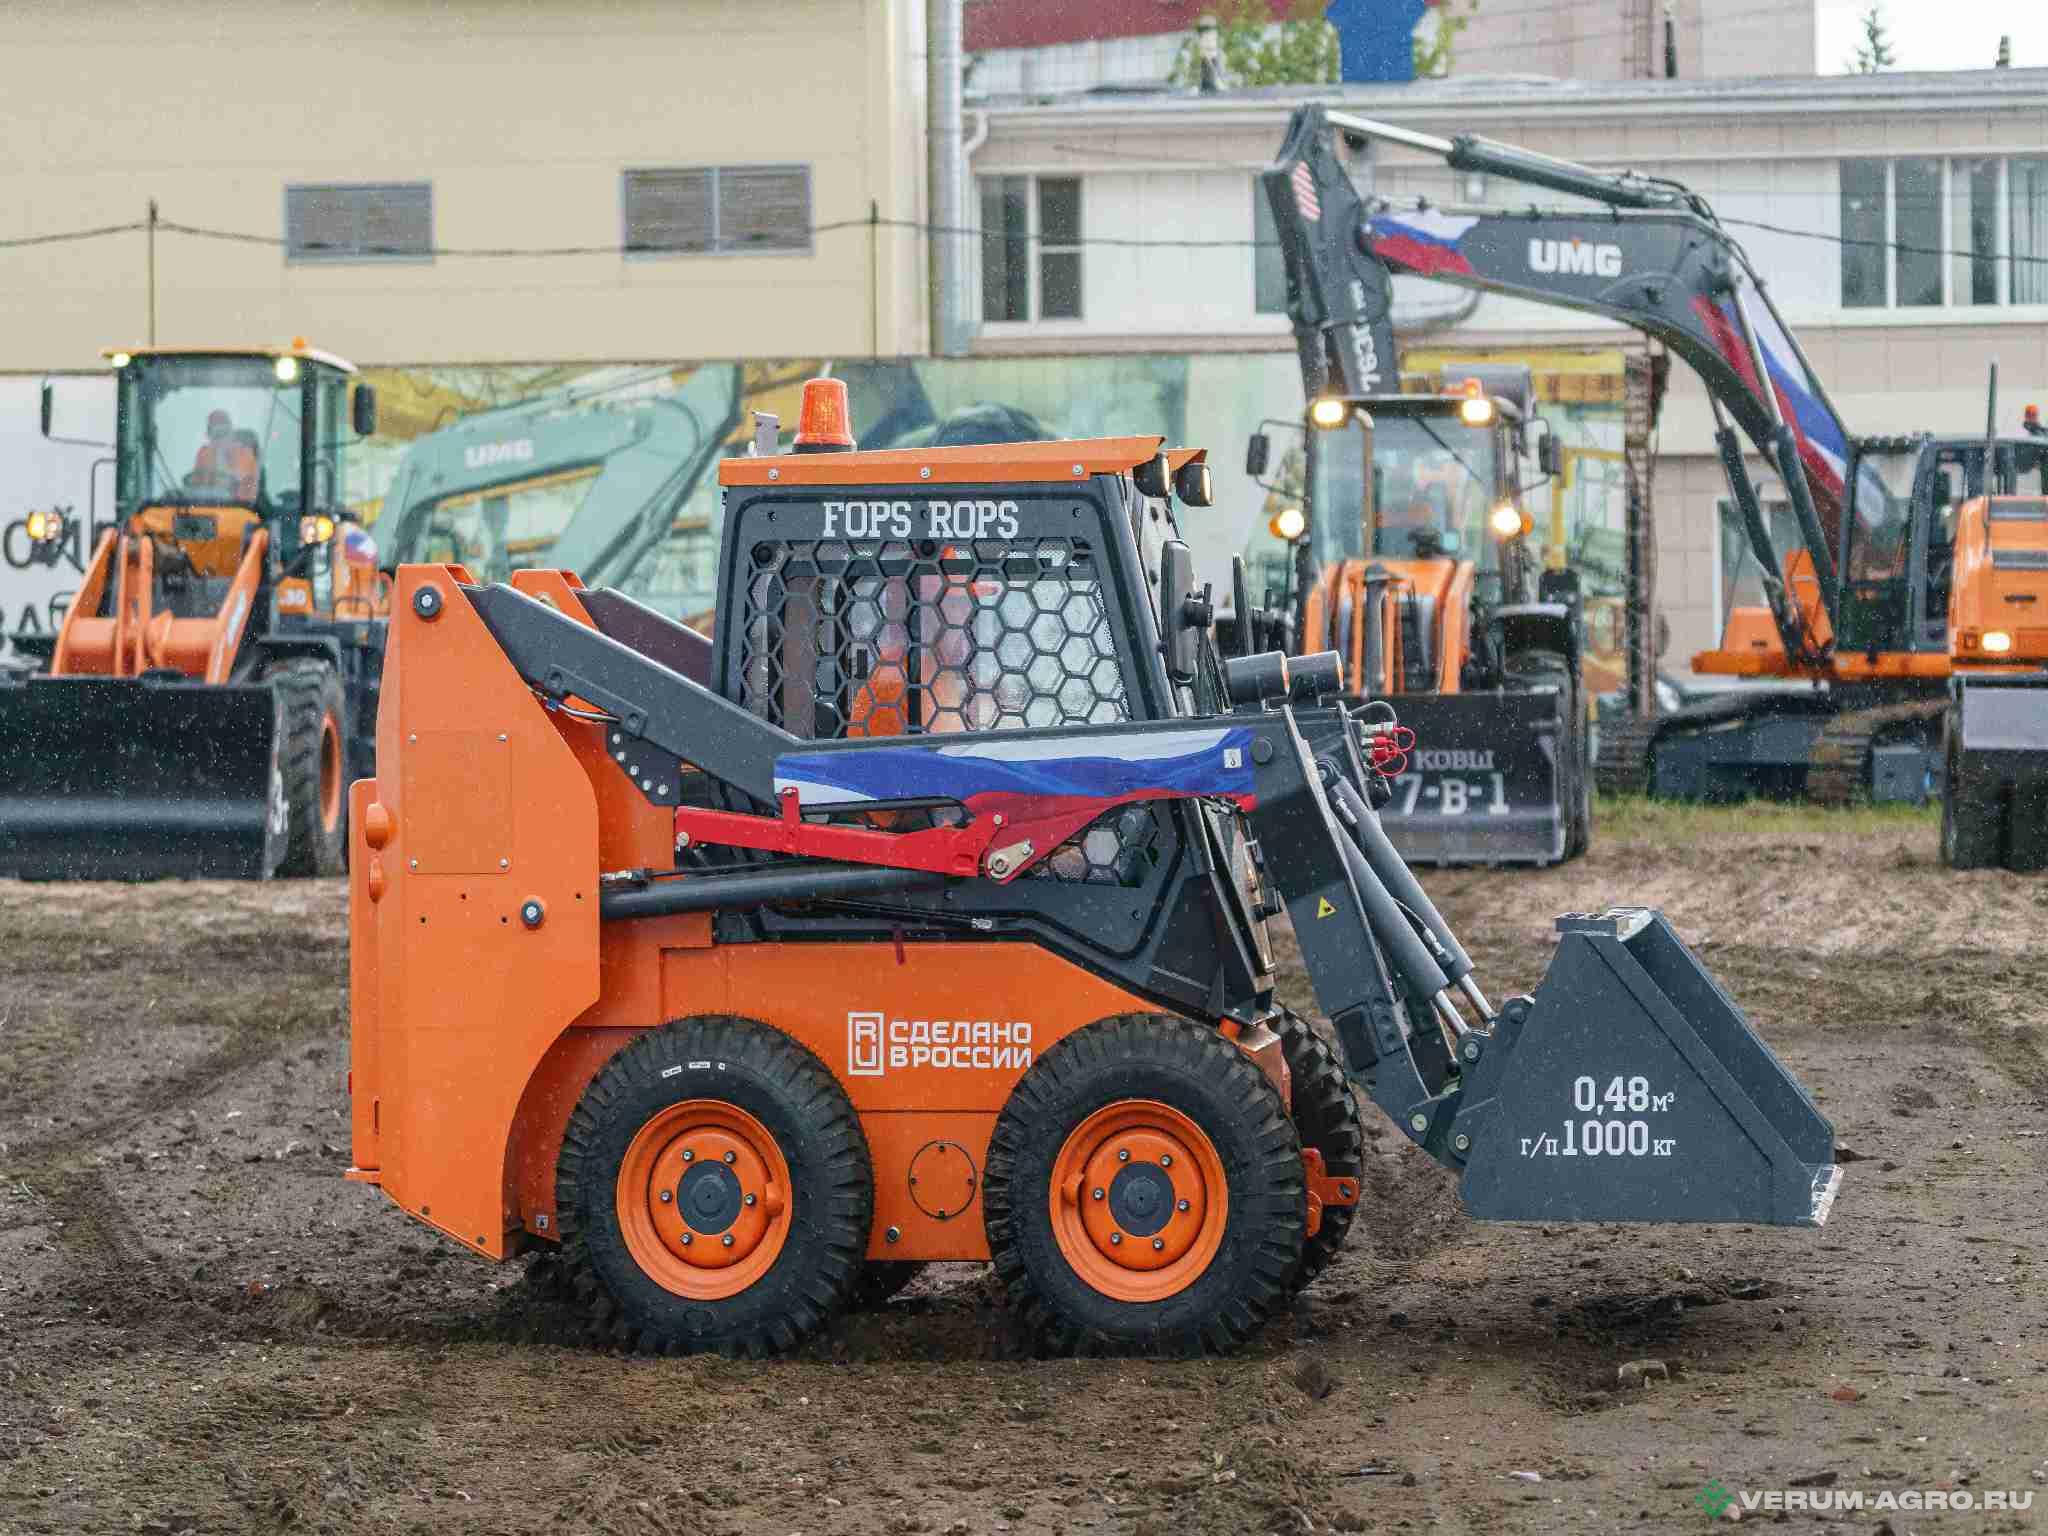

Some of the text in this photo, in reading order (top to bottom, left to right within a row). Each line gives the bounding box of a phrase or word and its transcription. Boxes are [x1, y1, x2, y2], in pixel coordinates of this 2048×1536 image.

[1529, 238, 1622, 277] UMG
[823, 500, 1019, 538] FOPS ROPS
[1394, 773, 1510, 817] 7-В-1
[889, 1020, 1032, 1044] СДЕЛАНО
[1574, 1076, 1649, 1115] 0,48
[1562, 1119, 1649, 1156] 1000
